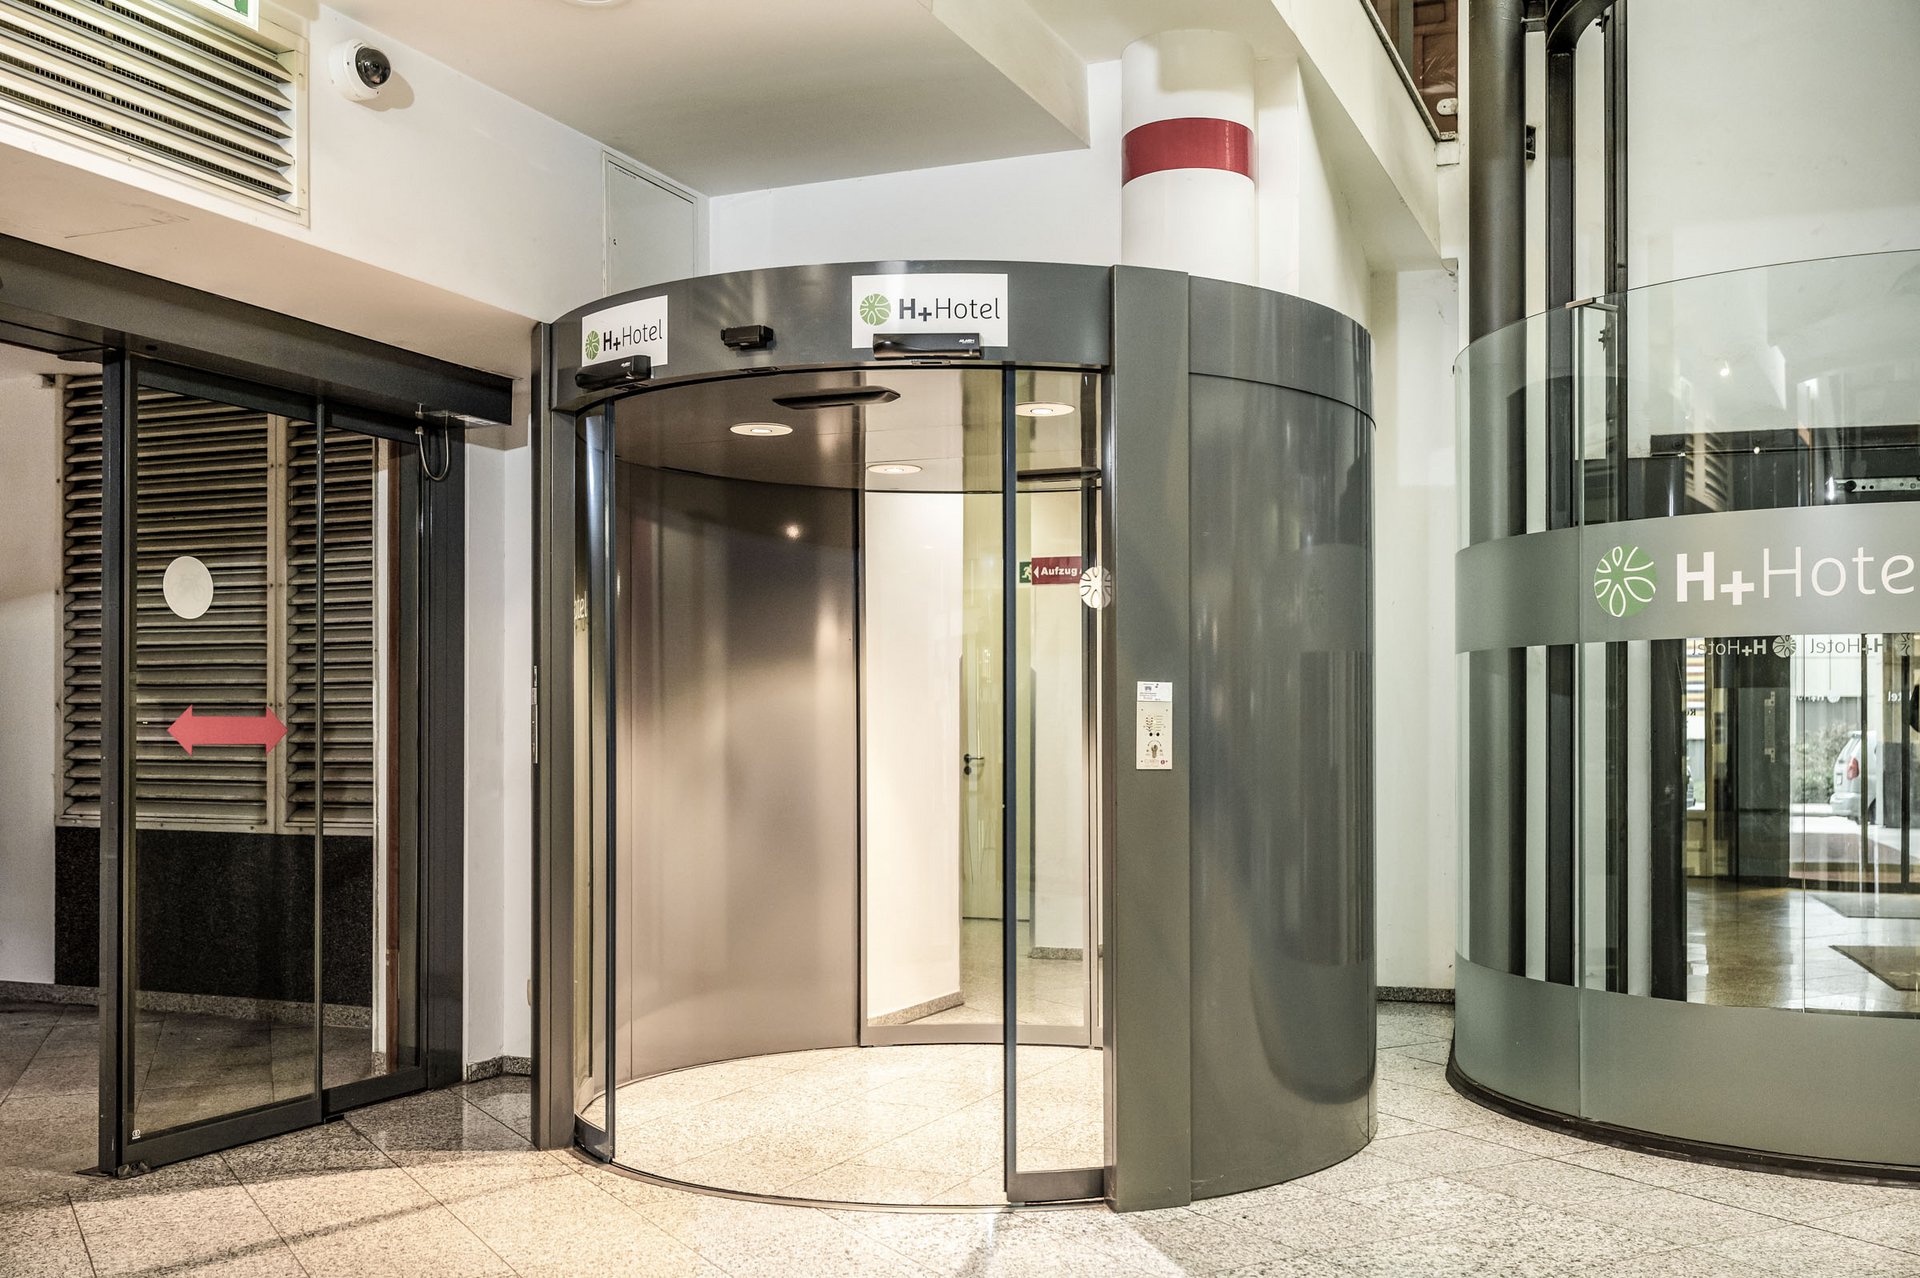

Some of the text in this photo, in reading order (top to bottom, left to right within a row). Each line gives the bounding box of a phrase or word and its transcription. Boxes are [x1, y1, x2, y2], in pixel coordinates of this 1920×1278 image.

[898, 297, 1000, 323] H+Hotel
[603, 318, 663, 352] H+Hotel
[1040, 566, 1078, 577] Aufzug
